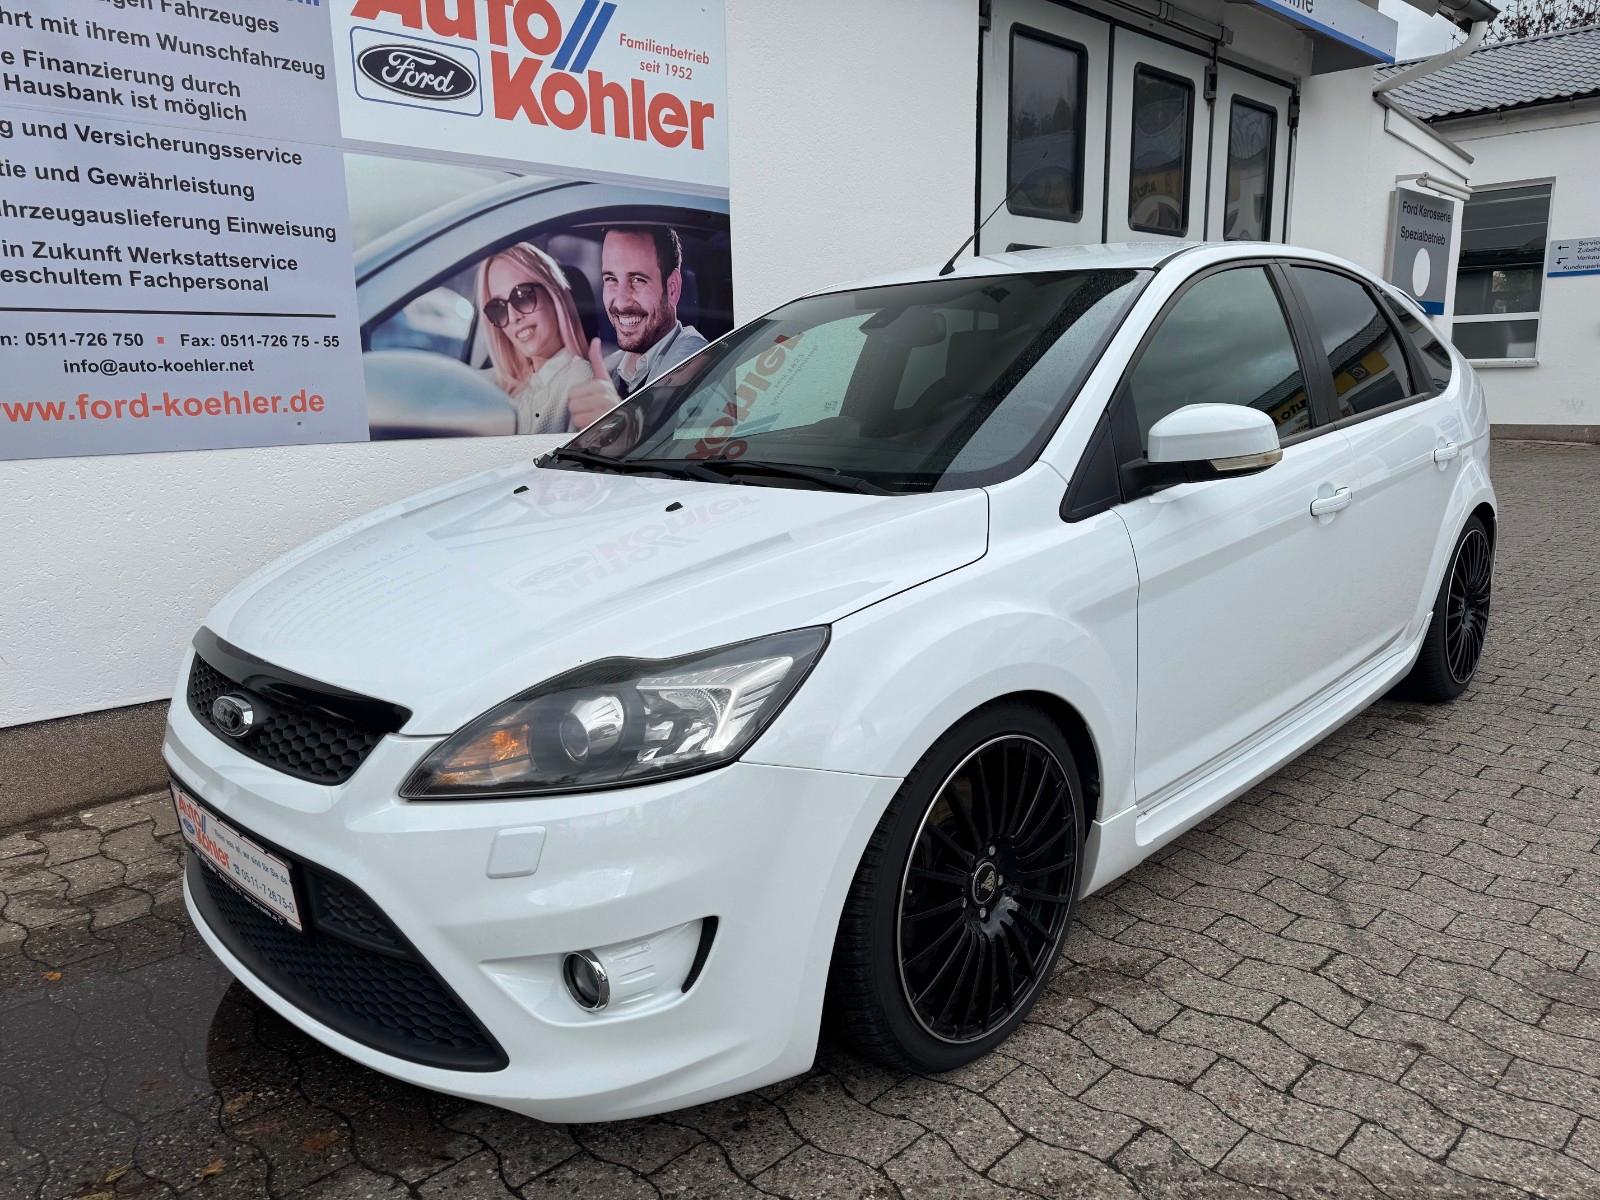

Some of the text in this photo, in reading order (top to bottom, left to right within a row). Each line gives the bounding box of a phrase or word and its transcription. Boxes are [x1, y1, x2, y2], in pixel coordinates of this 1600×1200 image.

[40, 17, 79, 37] mit
[85, 20, 151, 49] ihrem
[155, 32, 326, 80] Wunschfahrzeug
[619, 33, 710, 65] Familienbetrieb
[23, 49, 174, 92] Finanzierung
[181, 74, 241, 98] durch
[381, 51, 454, 93] Ford
[639, 60, 693, 81] seit 1952
[3, 72, 247, 122] Hausbank ist möglich
[22, 122, 67, 140] und
[74, 123, 303, 166] Versicherungsservice
[35, 166, 80, 182] und
[87, 166, 256, 202] Gewährleistung
[0, 200, 337, 242] hrzeugauslieferung Einweisung
[1402, 200, 1418, 216] Ford
[1400, 225, 1446, 246] Spezialbetrieb
[2, 240, 298, 271] in Zukunft Werkstattservice
[0, 266, 269, 293] eschultem Fachpersonal
[25, 332, 108, 346] 0511-726
[113, 333, 144, 347] 750
[180, 334, 215, 347] Fax:
[220, 335, 288, 347] 0511-726
[293, 335, 310, 347] 75
[323, 335, 339, 347] 55
[63, 359, 255, 376] info@auto-koehler.net
[0, 389, 326, 422] ww.ford-koehler.de
